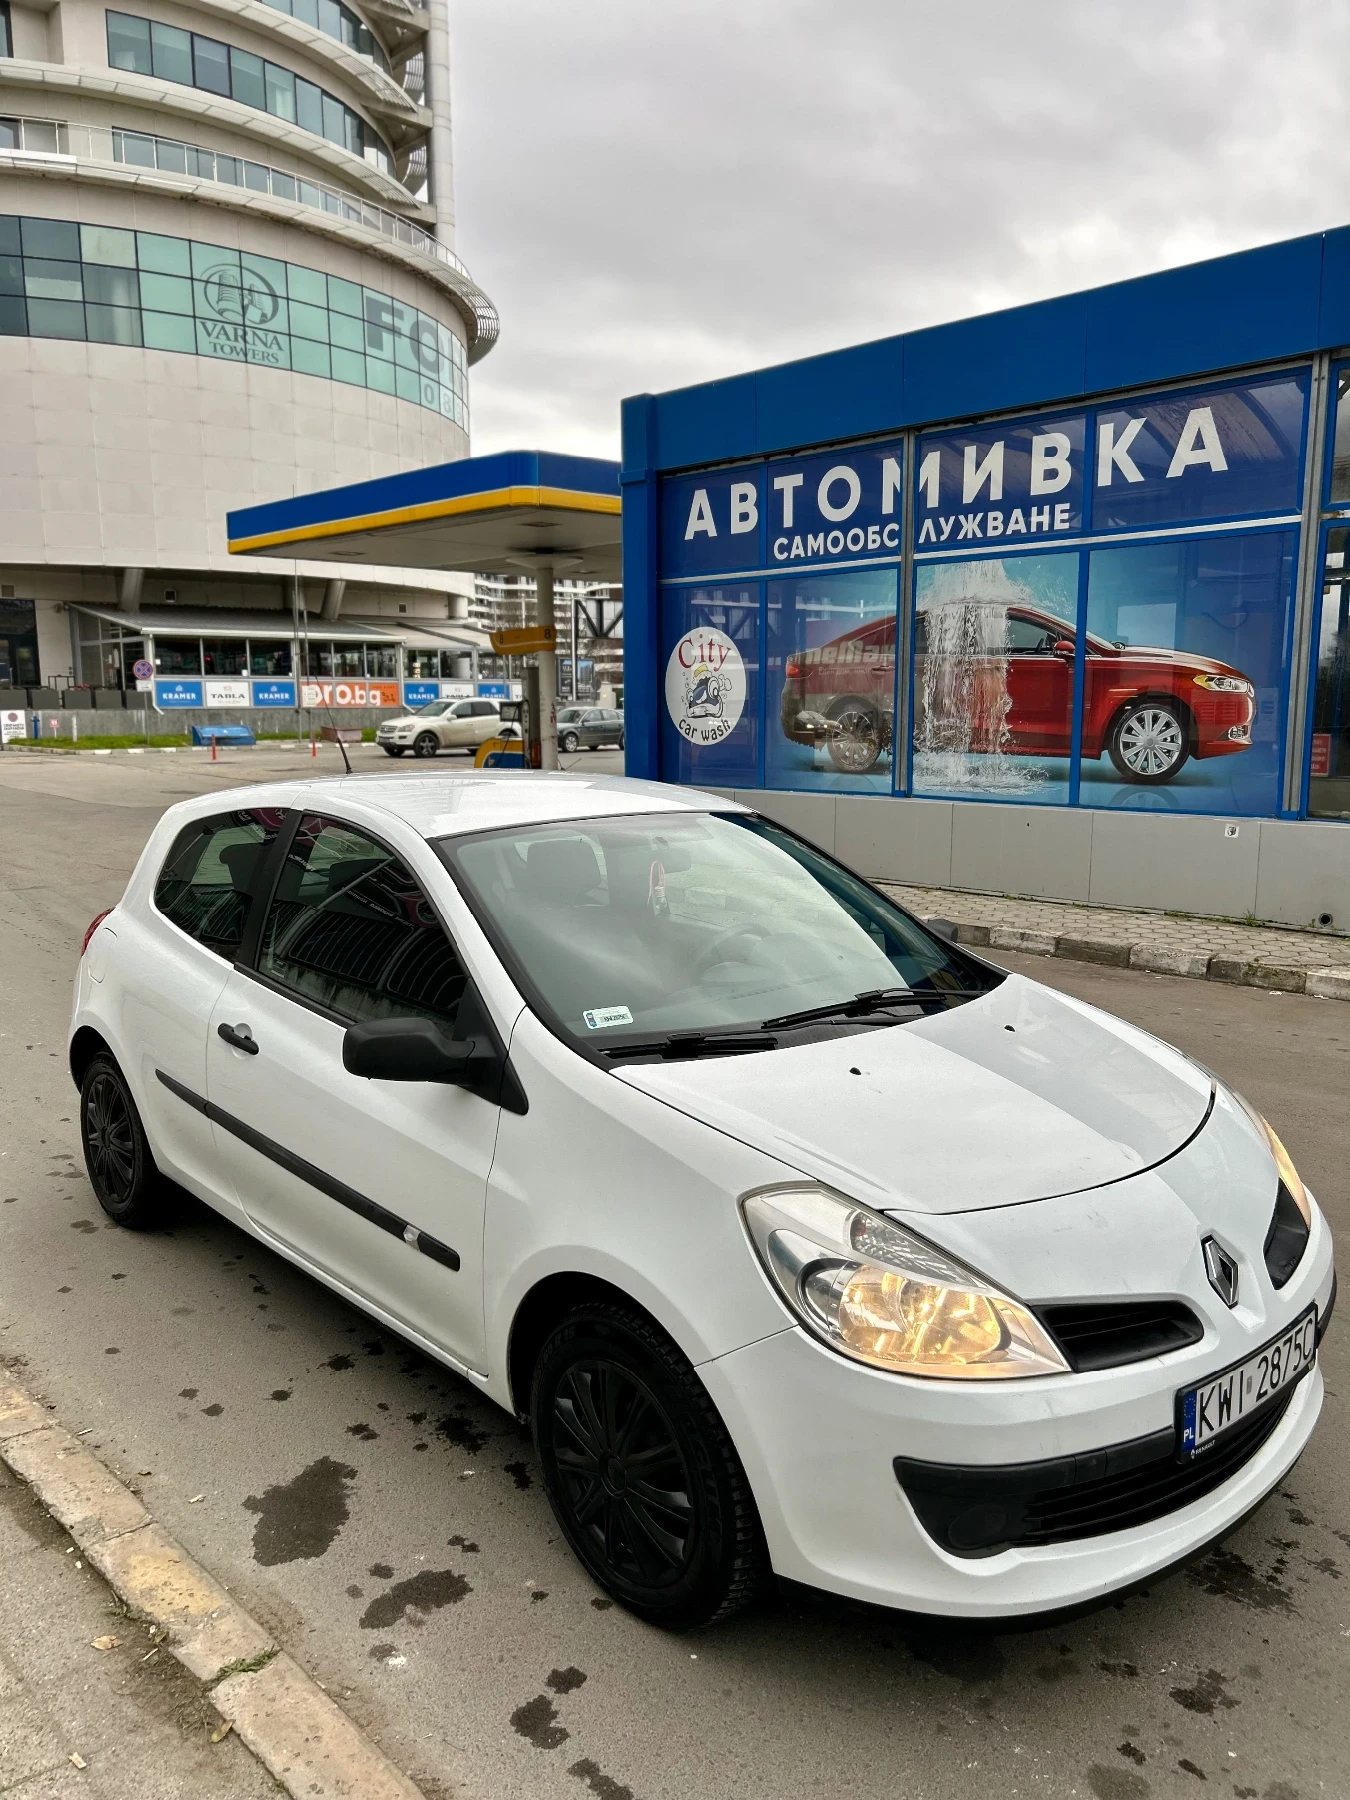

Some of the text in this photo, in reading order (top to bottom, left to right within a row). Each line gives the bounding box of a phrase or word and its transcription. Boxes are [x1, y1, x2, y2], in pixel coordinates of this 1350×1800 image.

[199, 321, 285, 352] VARNA
[208, 341, 280, 364] TOWERS
[684, 406, 1229, 541] АВТОМИВКА
[773, 502, 1071, 561] САМООБСЛУЖВАНЕ
[544, 628, 552, 640] 8
[678, 634, 732, 672] City
[162, 692, 197, 700] KRAMER
[258, 692, 290, 700] KRAMER
[678, 719, 731, 742] car wash
[1198, 1317, 1313, 1439] KWI 2875C
[1183, 1426, 1194, 1443] PL
